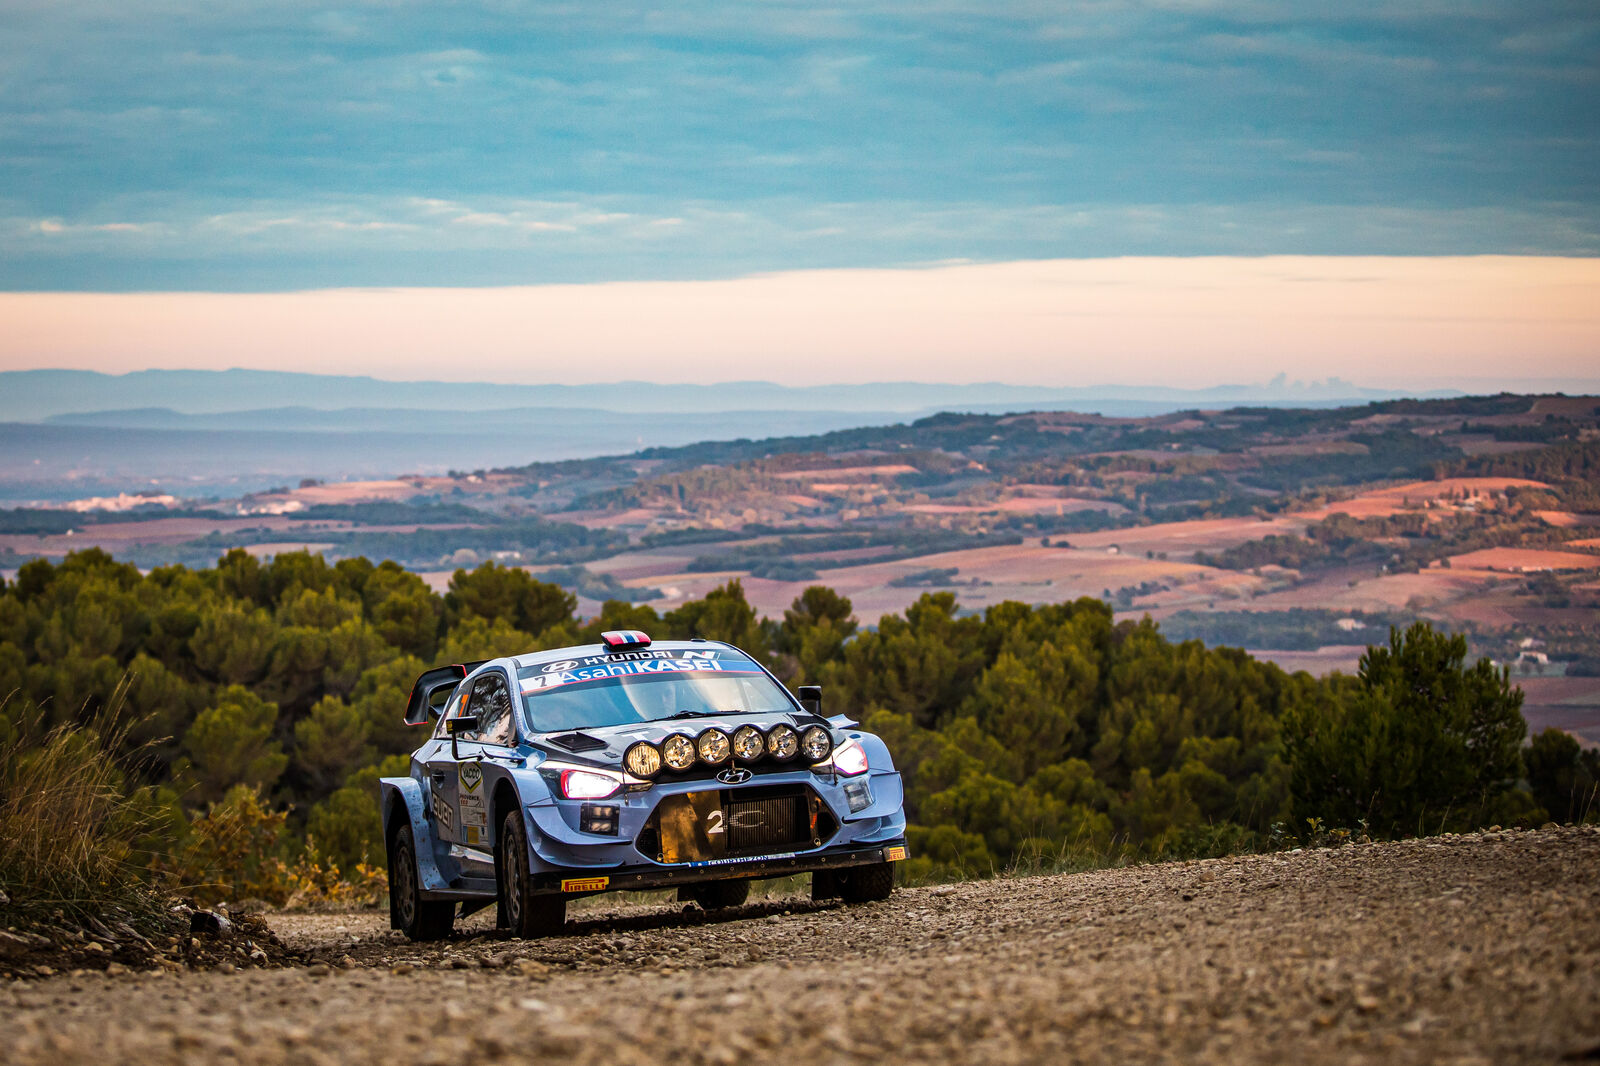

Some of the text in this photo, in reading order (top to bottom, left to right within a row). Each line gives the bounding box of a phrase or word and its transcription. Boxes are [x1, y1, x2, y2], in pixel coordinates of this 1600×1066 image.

[585, 651, 672, 666] HYUNDAI
[463, 767, 480, 780] YACCO
[565, 879, 605, 892] PIRELLI
